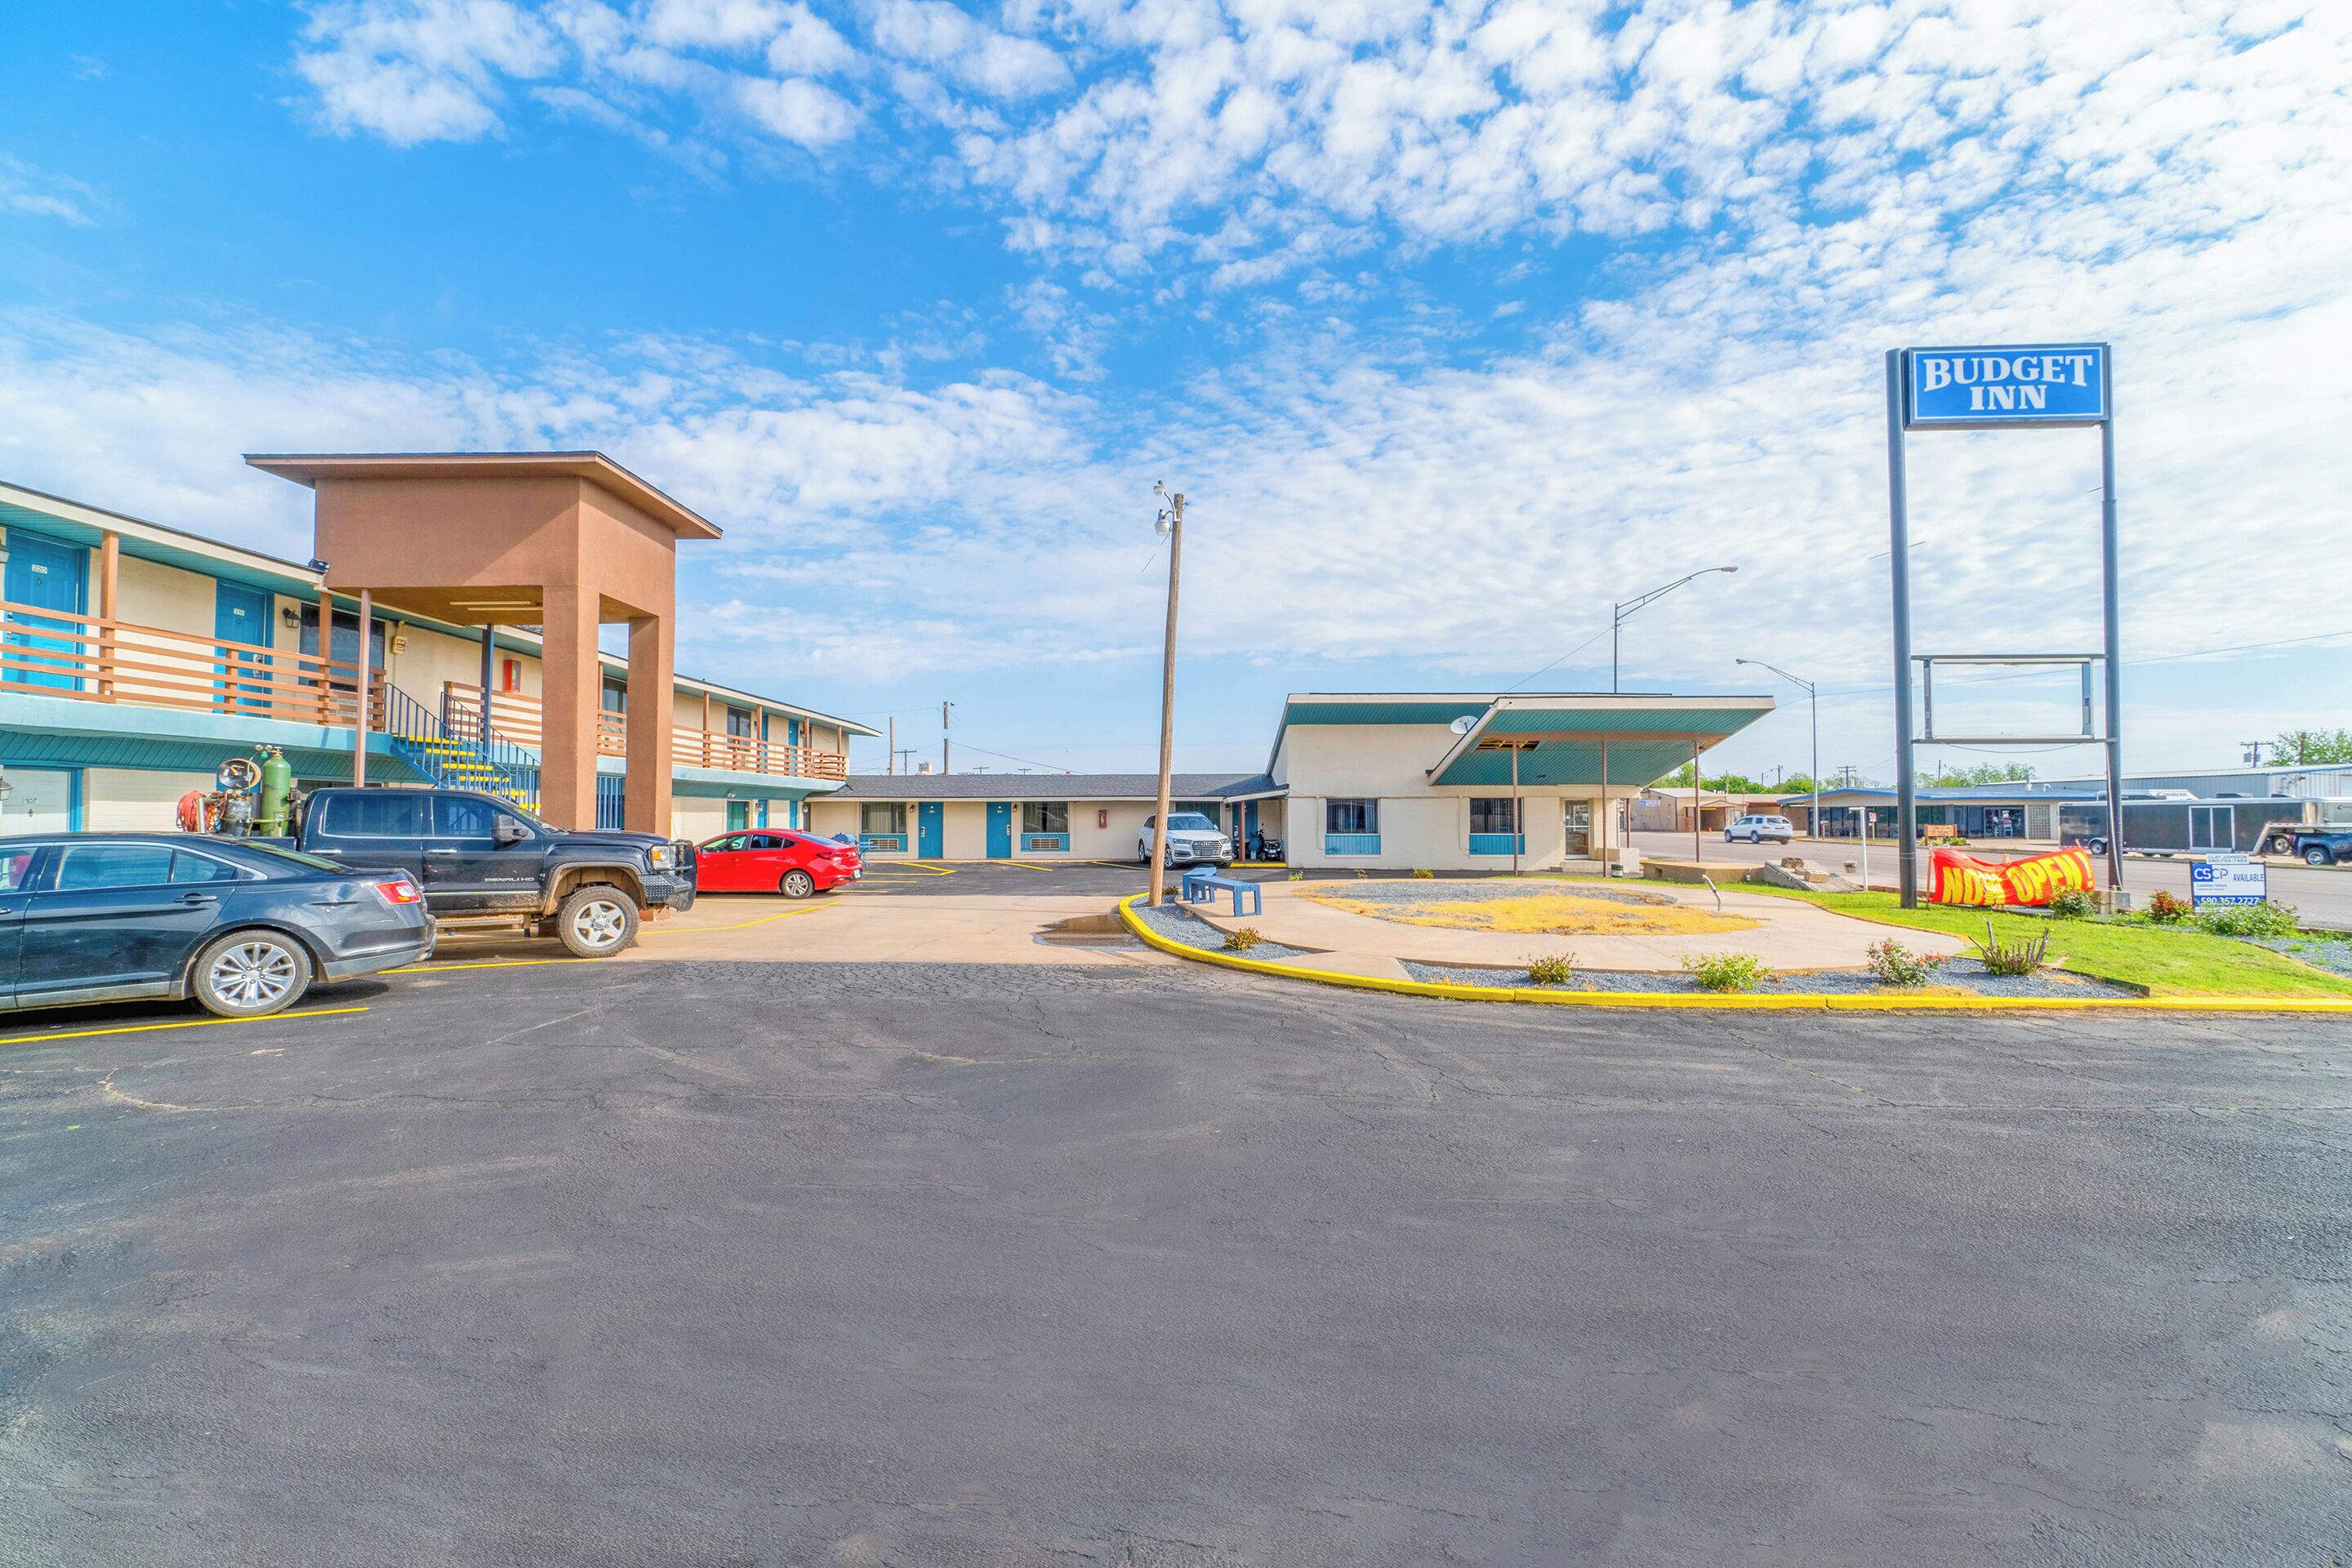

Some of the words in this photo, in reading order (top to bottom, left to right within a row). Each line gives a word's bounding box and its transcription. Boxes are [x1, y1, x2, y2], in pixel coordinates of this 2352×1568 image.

[1923, 355, 2093, 392] BUDGET
[1970, 385, 2047, 411] INN
[33, 564, 47, 573] 220
[2194, 868, 2229, 880] CSCP
[2233, 873, 2265, 882] AVAILABLE
